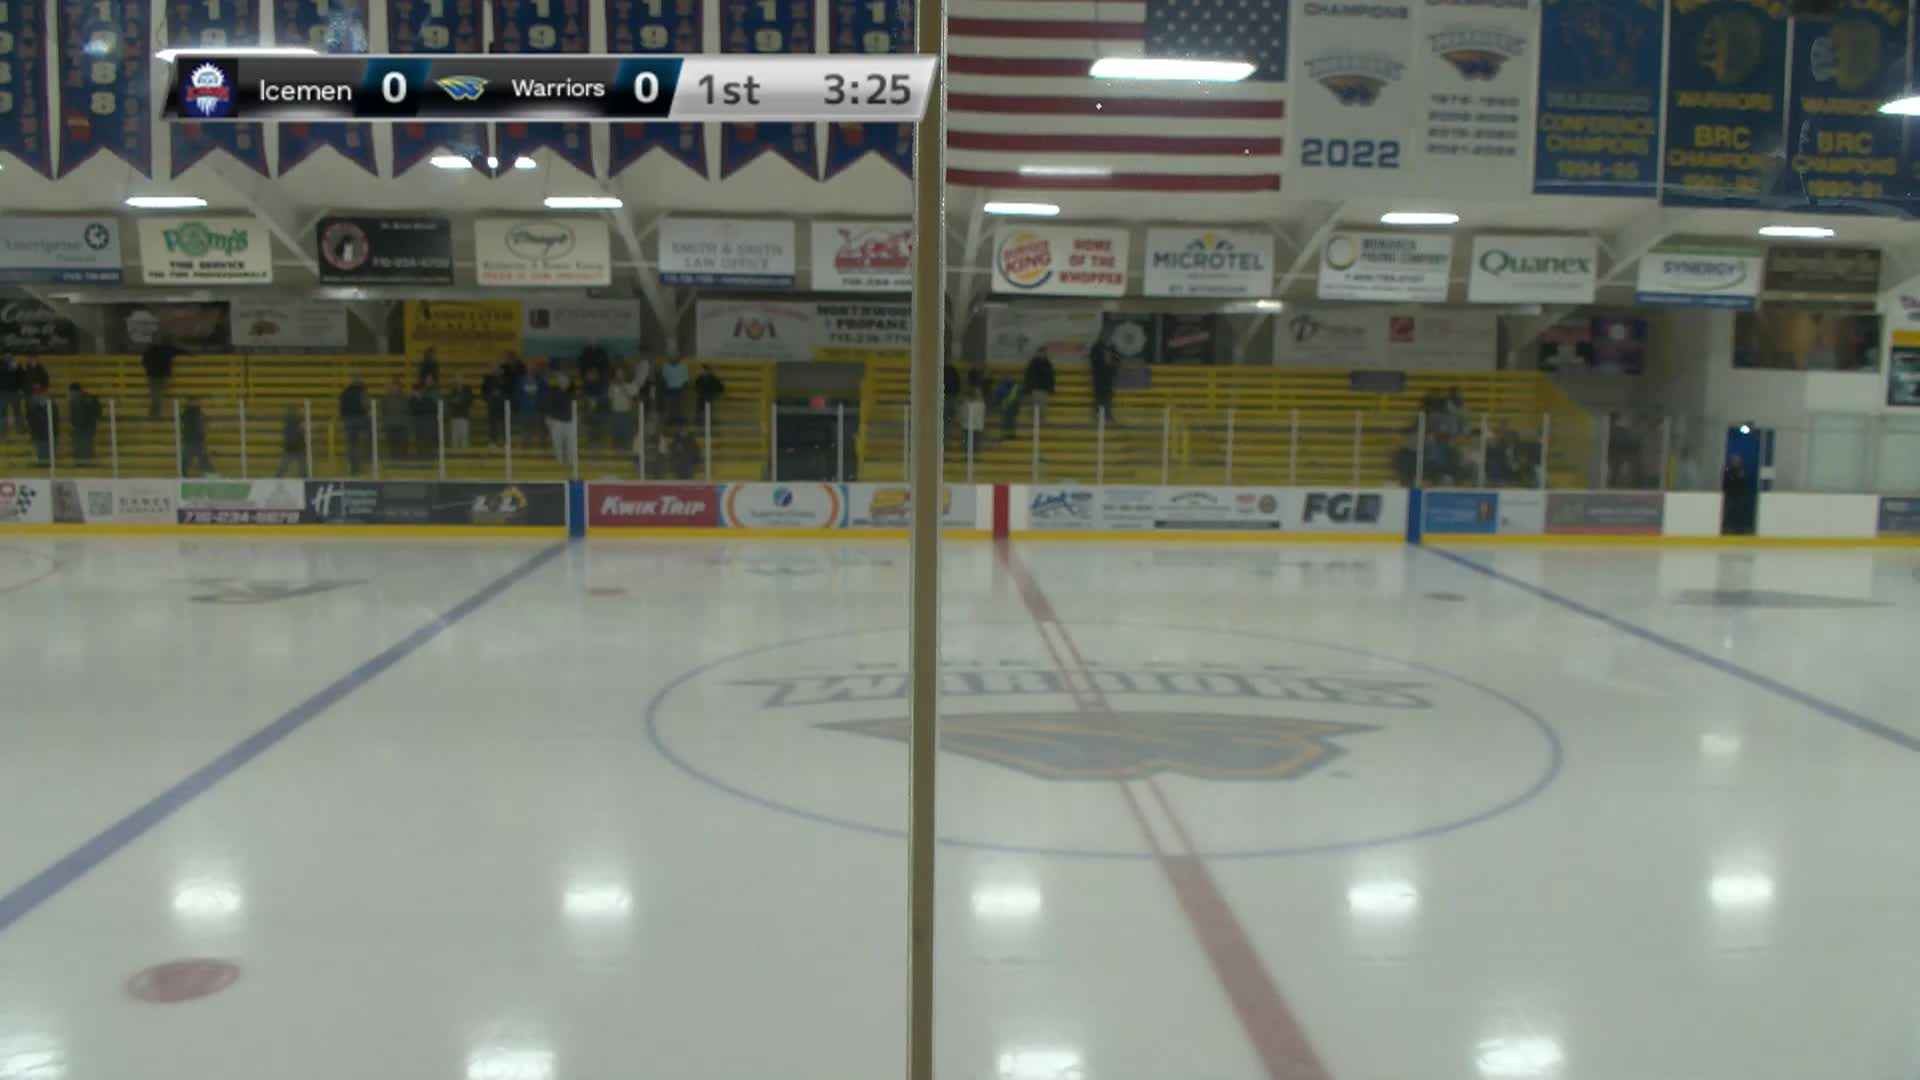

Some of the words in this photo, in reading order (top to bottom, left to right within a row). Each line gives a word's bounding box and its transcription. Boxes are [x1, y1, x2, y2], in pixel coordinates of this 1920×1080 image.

[1694, 125, 1751, 149] BRC
[1816, 131, 1873, 153] BRC
[1300, 138, 1400, 168] 2022
[1072, 238, 1112, 251] HOME
[1004, 253, 1051, 274] KING
[1068, 253, 1085, 267] OF
[1089, 254, 1116, 268] THE
[1151, 251, 1265, 271] MICROTEL
[1478, 249, 1592, 275] Quanex
[1058, 270, 1123, 285] WHOPPER
[600, 494, 656, 516] KWIK
[659, 494, 707, 516] TRIP
